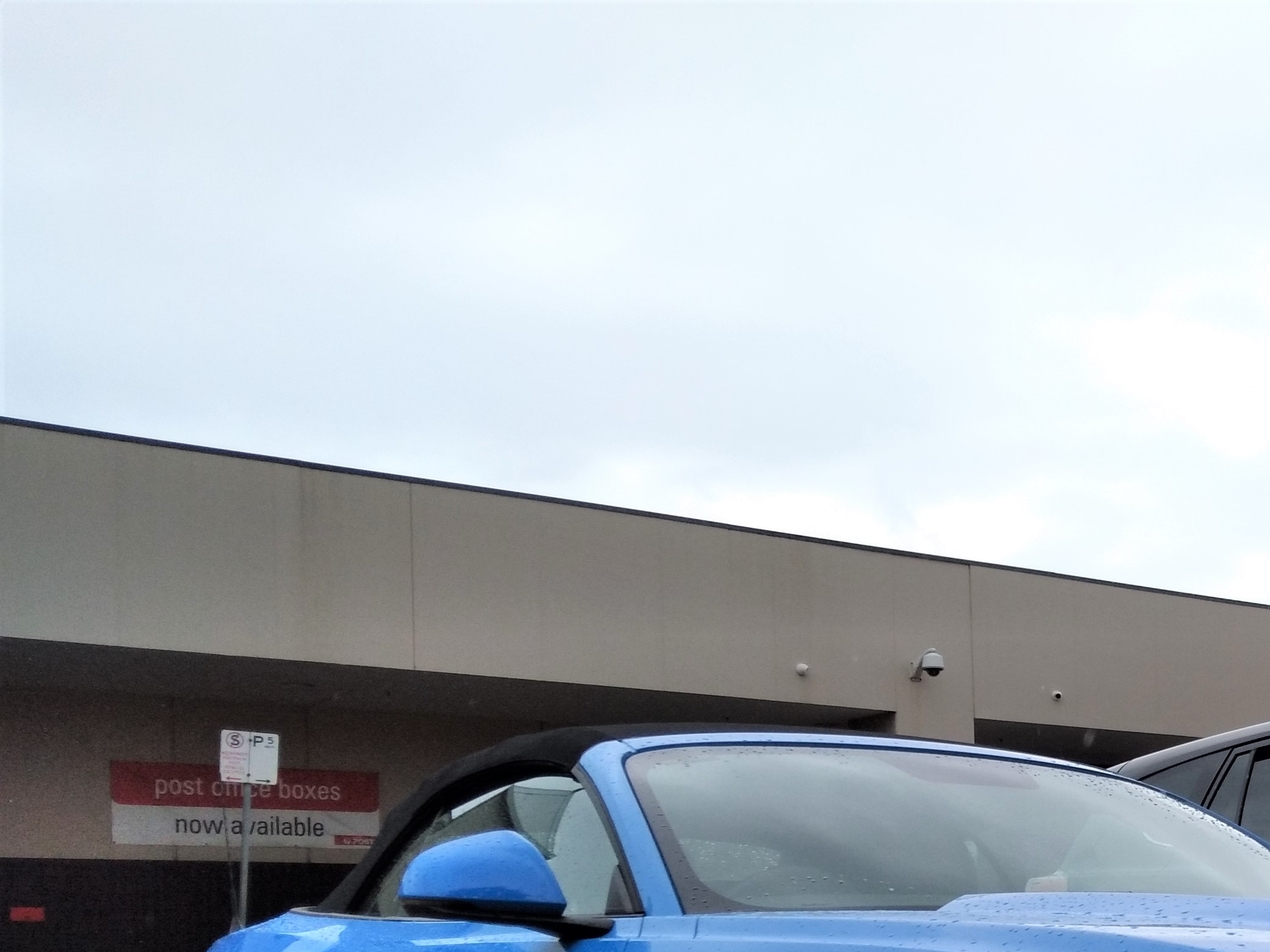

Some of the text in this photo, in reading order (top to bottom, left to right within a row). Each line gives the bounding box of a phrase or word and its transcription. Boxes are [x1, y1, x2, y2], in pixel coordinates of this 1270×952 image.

[155, 777, 205, 799] post
[279, 782, 341, 801] boxes
[175, 817, 224, 835] now
